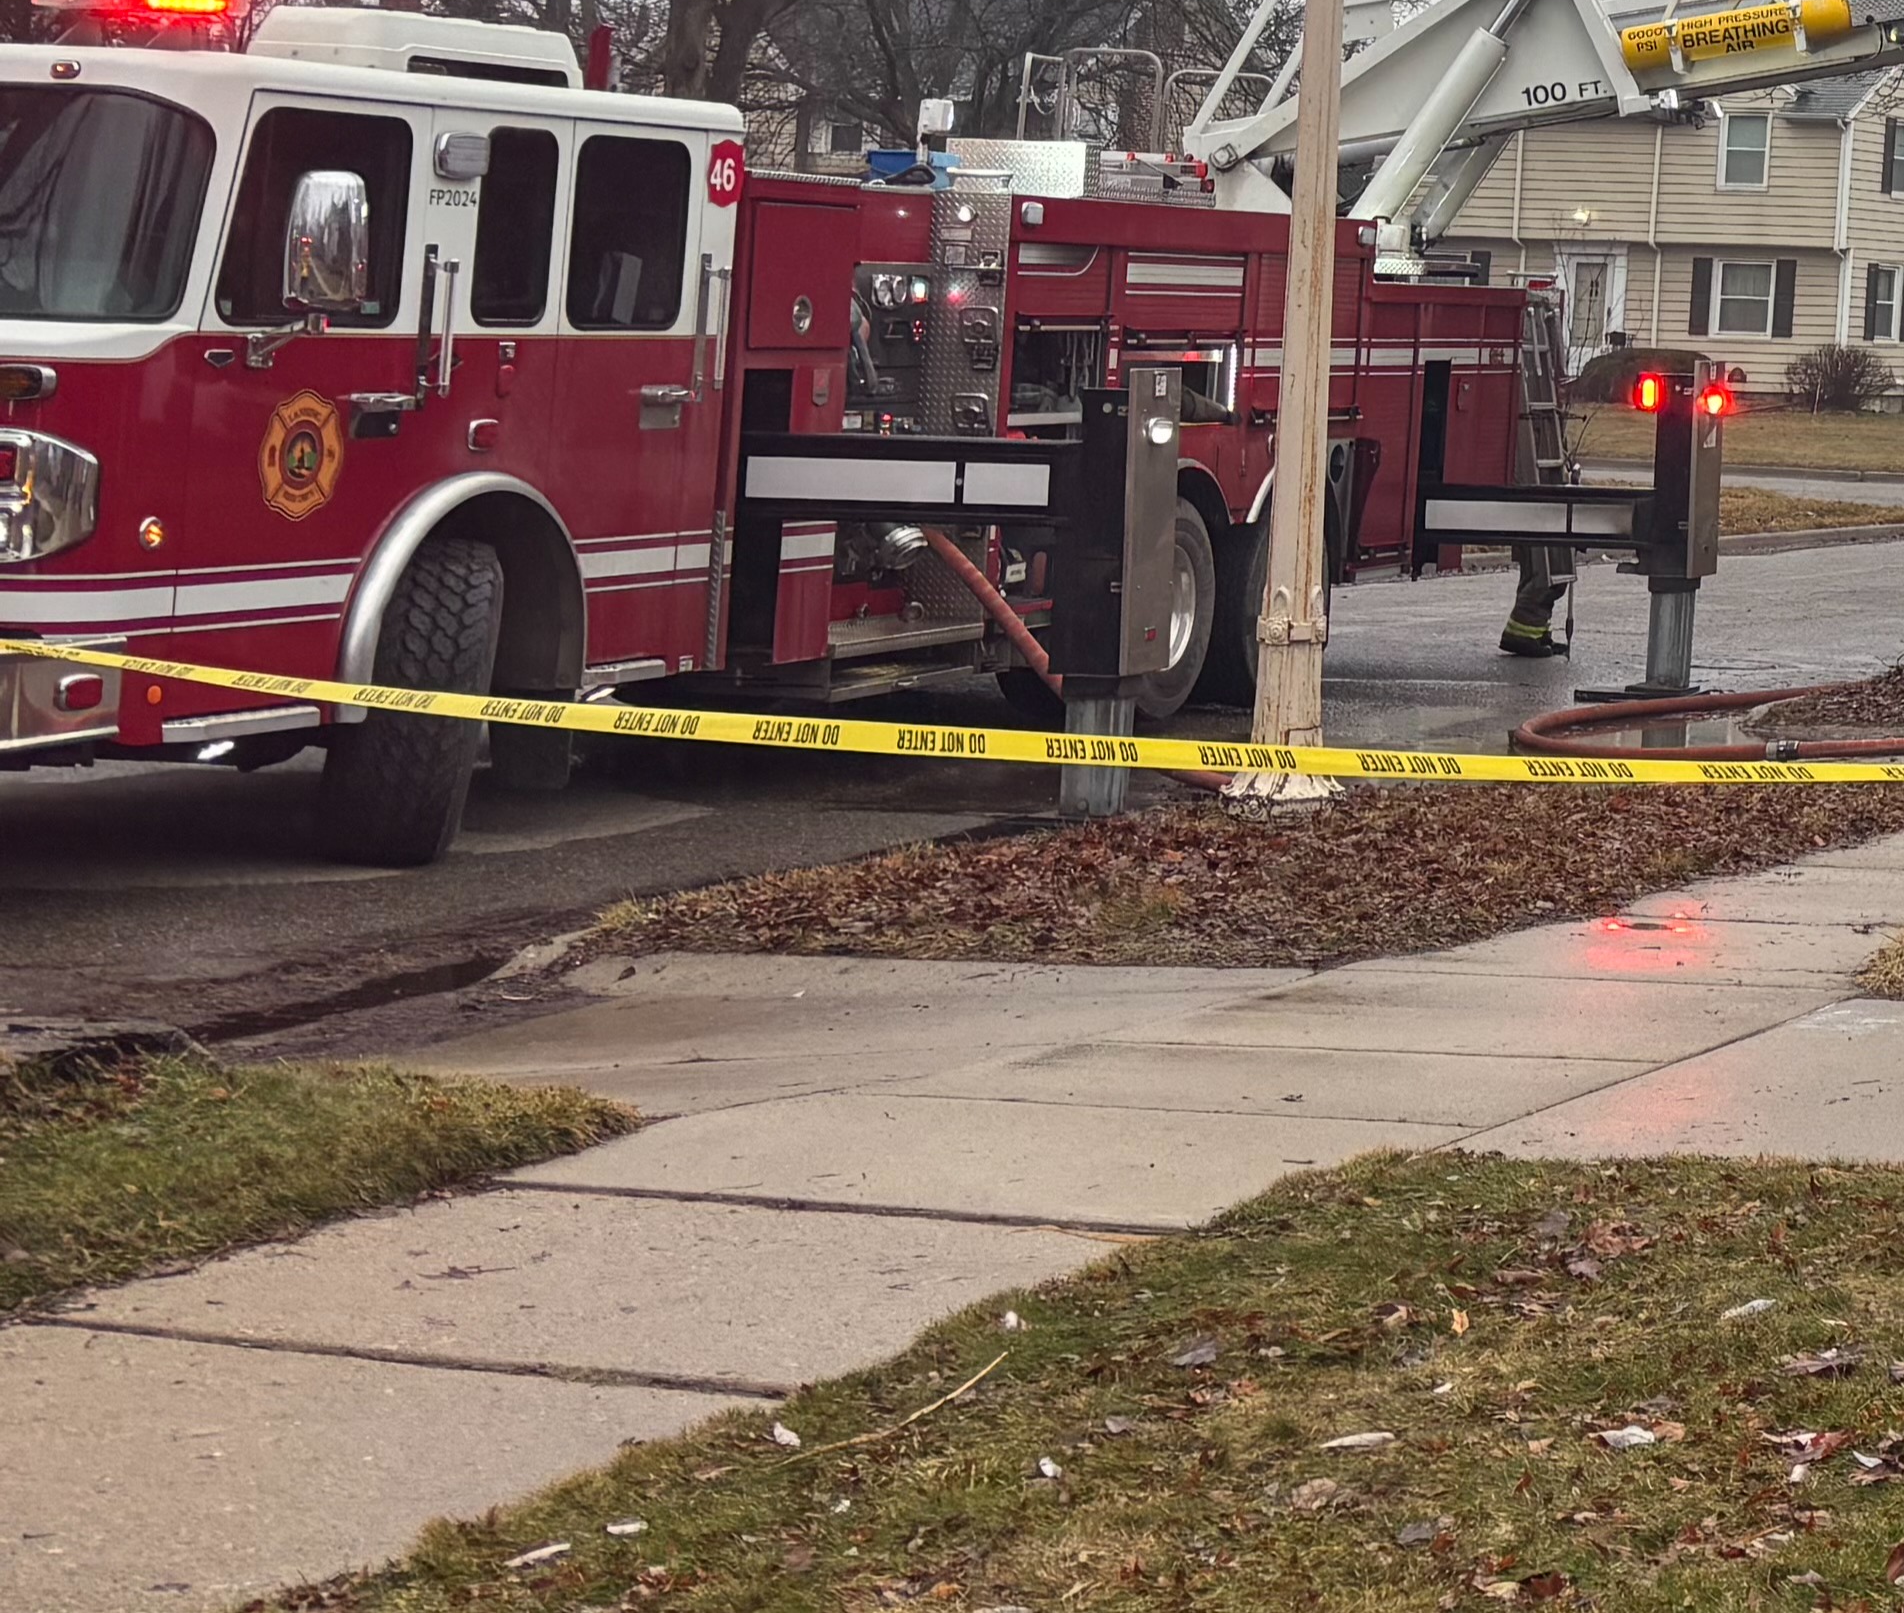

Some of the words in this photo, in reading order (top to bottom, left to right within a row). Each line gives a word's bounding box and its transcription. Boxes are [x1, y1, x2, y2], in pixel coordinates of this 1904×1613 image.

[1681, 19, 1713, 32] HIGH
[1718, 7, 1787, 26] PRESSURE
[1627, 27, 1665, 41] 6000
[1682, 18, 1790, 49] BREATHING
[1636, 40, 1658, 53] PSI
[1725, 40, 1755, 54] AIR
[1521, 81, 1567, 107] 100
[1578, 79, 1608, 99] FT.
[710, 157, 736, 192] 46
[429, 188, 477, 208] FP2024
[481, 699, 517, 720] ENTER
[518, 703, 543, 722] NOT
[545, 705, 566, 723] DO
[613, 710, 655, 731] ENTER
[652, 713, 679, 733] NOT
[680, 715, 700, 735] DO
[753, 719, 793, 742] ENTER
[793, 722, 820, 744] NOT
[822, 724, 841, 745] DO
[897, 728, 936, 751] ENTER
[939, 730, 965, 753] NOT
[969, 733, 986, 754] DO
[1045, 737, 1087, 759] ENTER
[1090, 739, 1116, 761] NOT
[1120, 741, 1139, 762] DO
[1197, 745, 1243, 767] ENTER
[1245, 748, 1273, 768] NOT
[1276, 749, 1297, 769] DO
[1356, 752, 1403, 772] ENTER
[1406, 755, 1437, 773] NOT
[1437, 757, 1462, 775] DO
[1522, 759, 1574, 777] ENTER
[1575, 761, 1610, 778] NOT
[1608, 762, 1634, 778] DO
[1698, 764, 1752, 779] ENTER
[1752, 765, 1786, 780] NOT
[1785, 766, 1815, 780] DO
